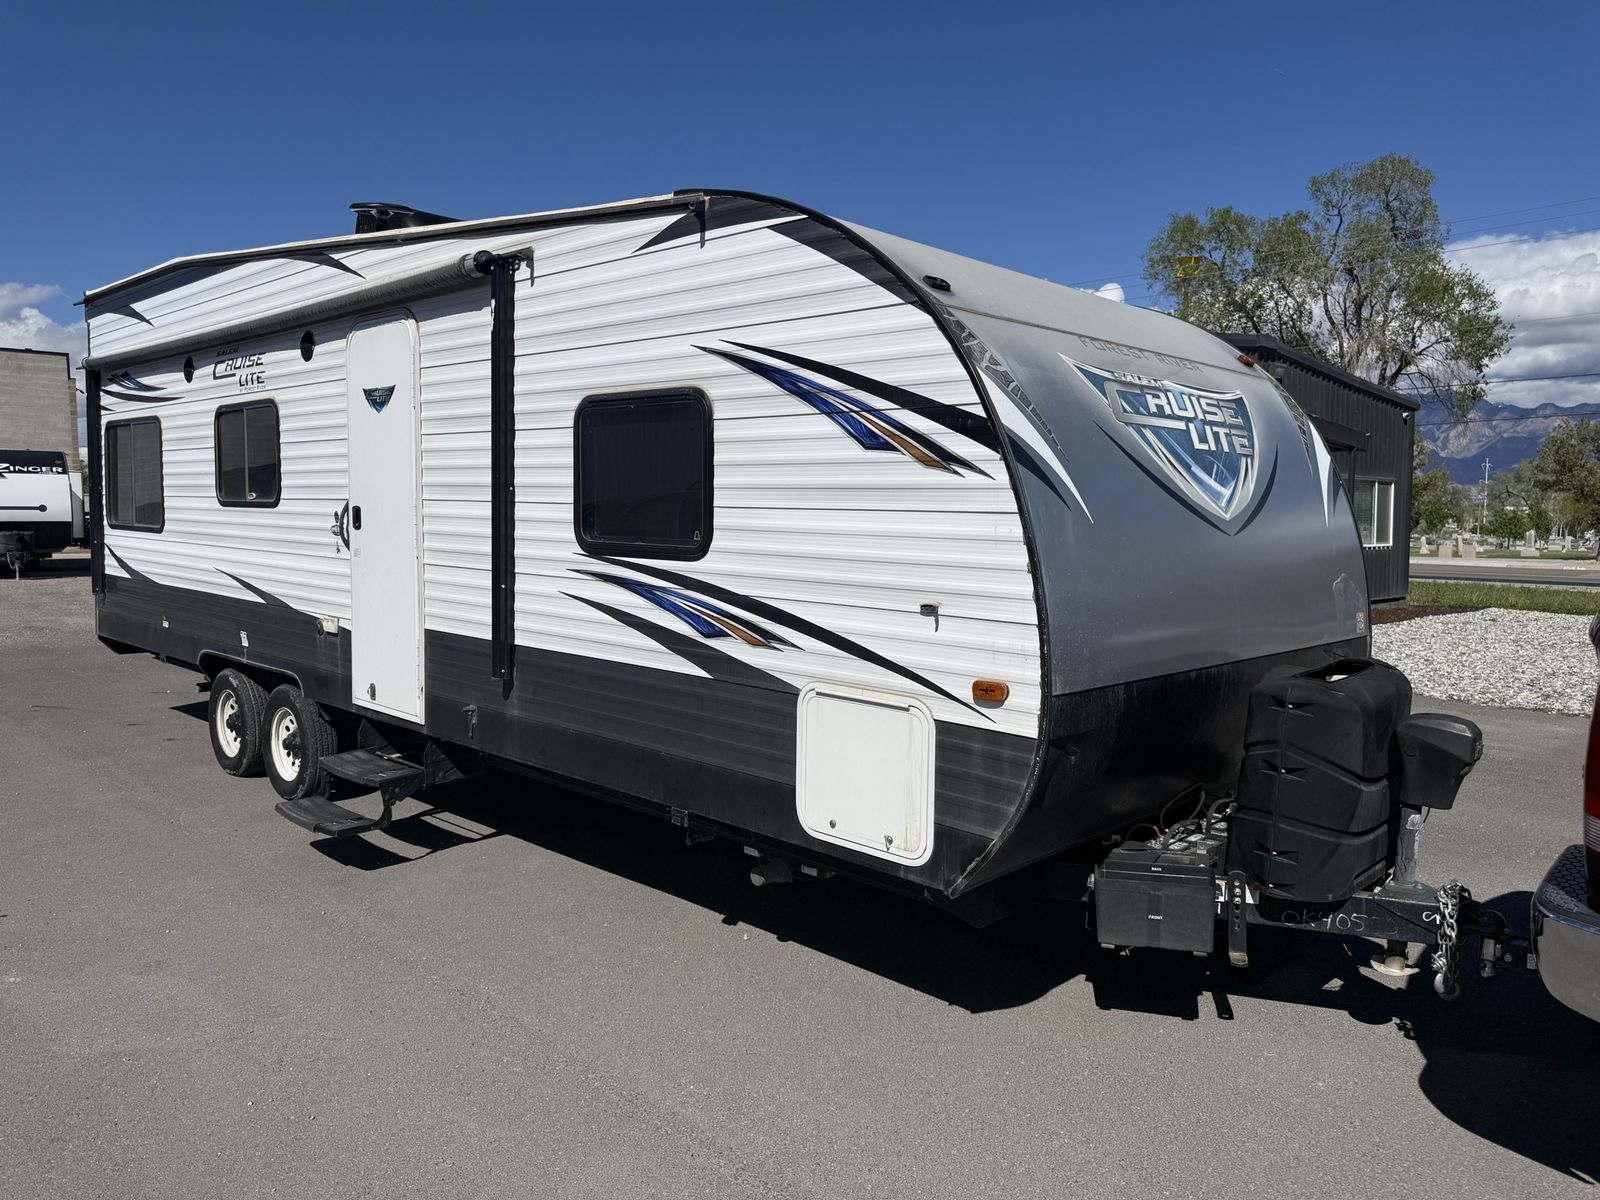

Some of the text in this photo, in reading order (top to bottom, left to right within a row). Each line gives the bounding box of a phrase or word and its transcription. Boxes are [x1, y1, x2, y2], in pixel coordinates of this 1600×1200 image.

[213, 352, 267, 380] CRUISE
[1078, 336, 1204, 373] FOREST RIVER
[239, 370, 266, 387] LITE
[1112, 370, 1165, 388] SALEM
[1104, 380, 1243, 430] CRUISE
[1188, 422, 1253, 456] LITE
